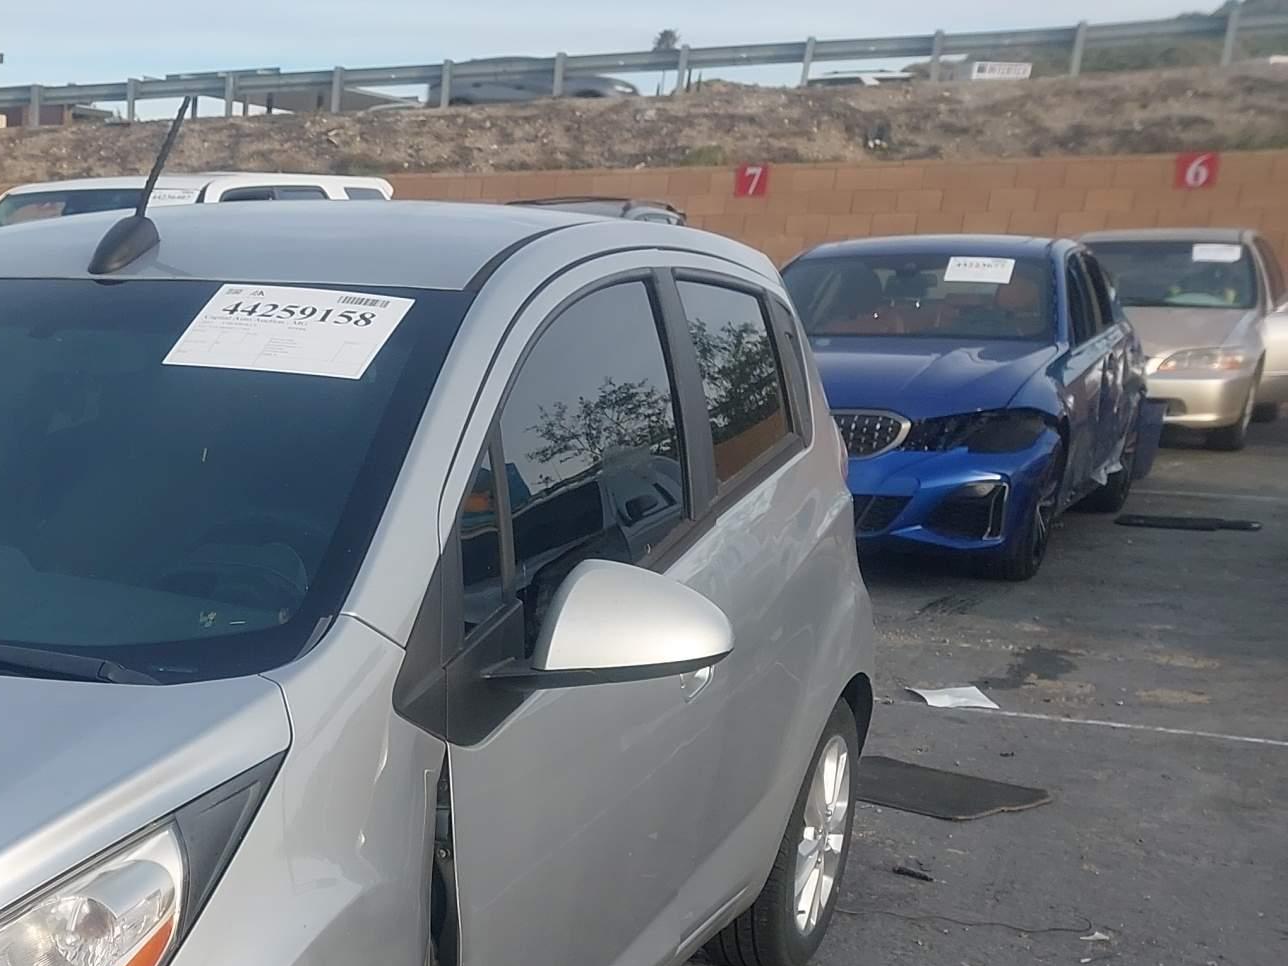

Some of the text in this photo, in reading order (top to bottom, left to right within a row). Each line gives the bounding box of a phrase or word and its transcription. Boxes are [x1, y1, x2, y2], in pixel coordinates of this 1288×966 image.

[745, 166, 762, 195] 7
[1185, 154, 1210, 187] 6
[222, 300, 377, 328] 44259158
